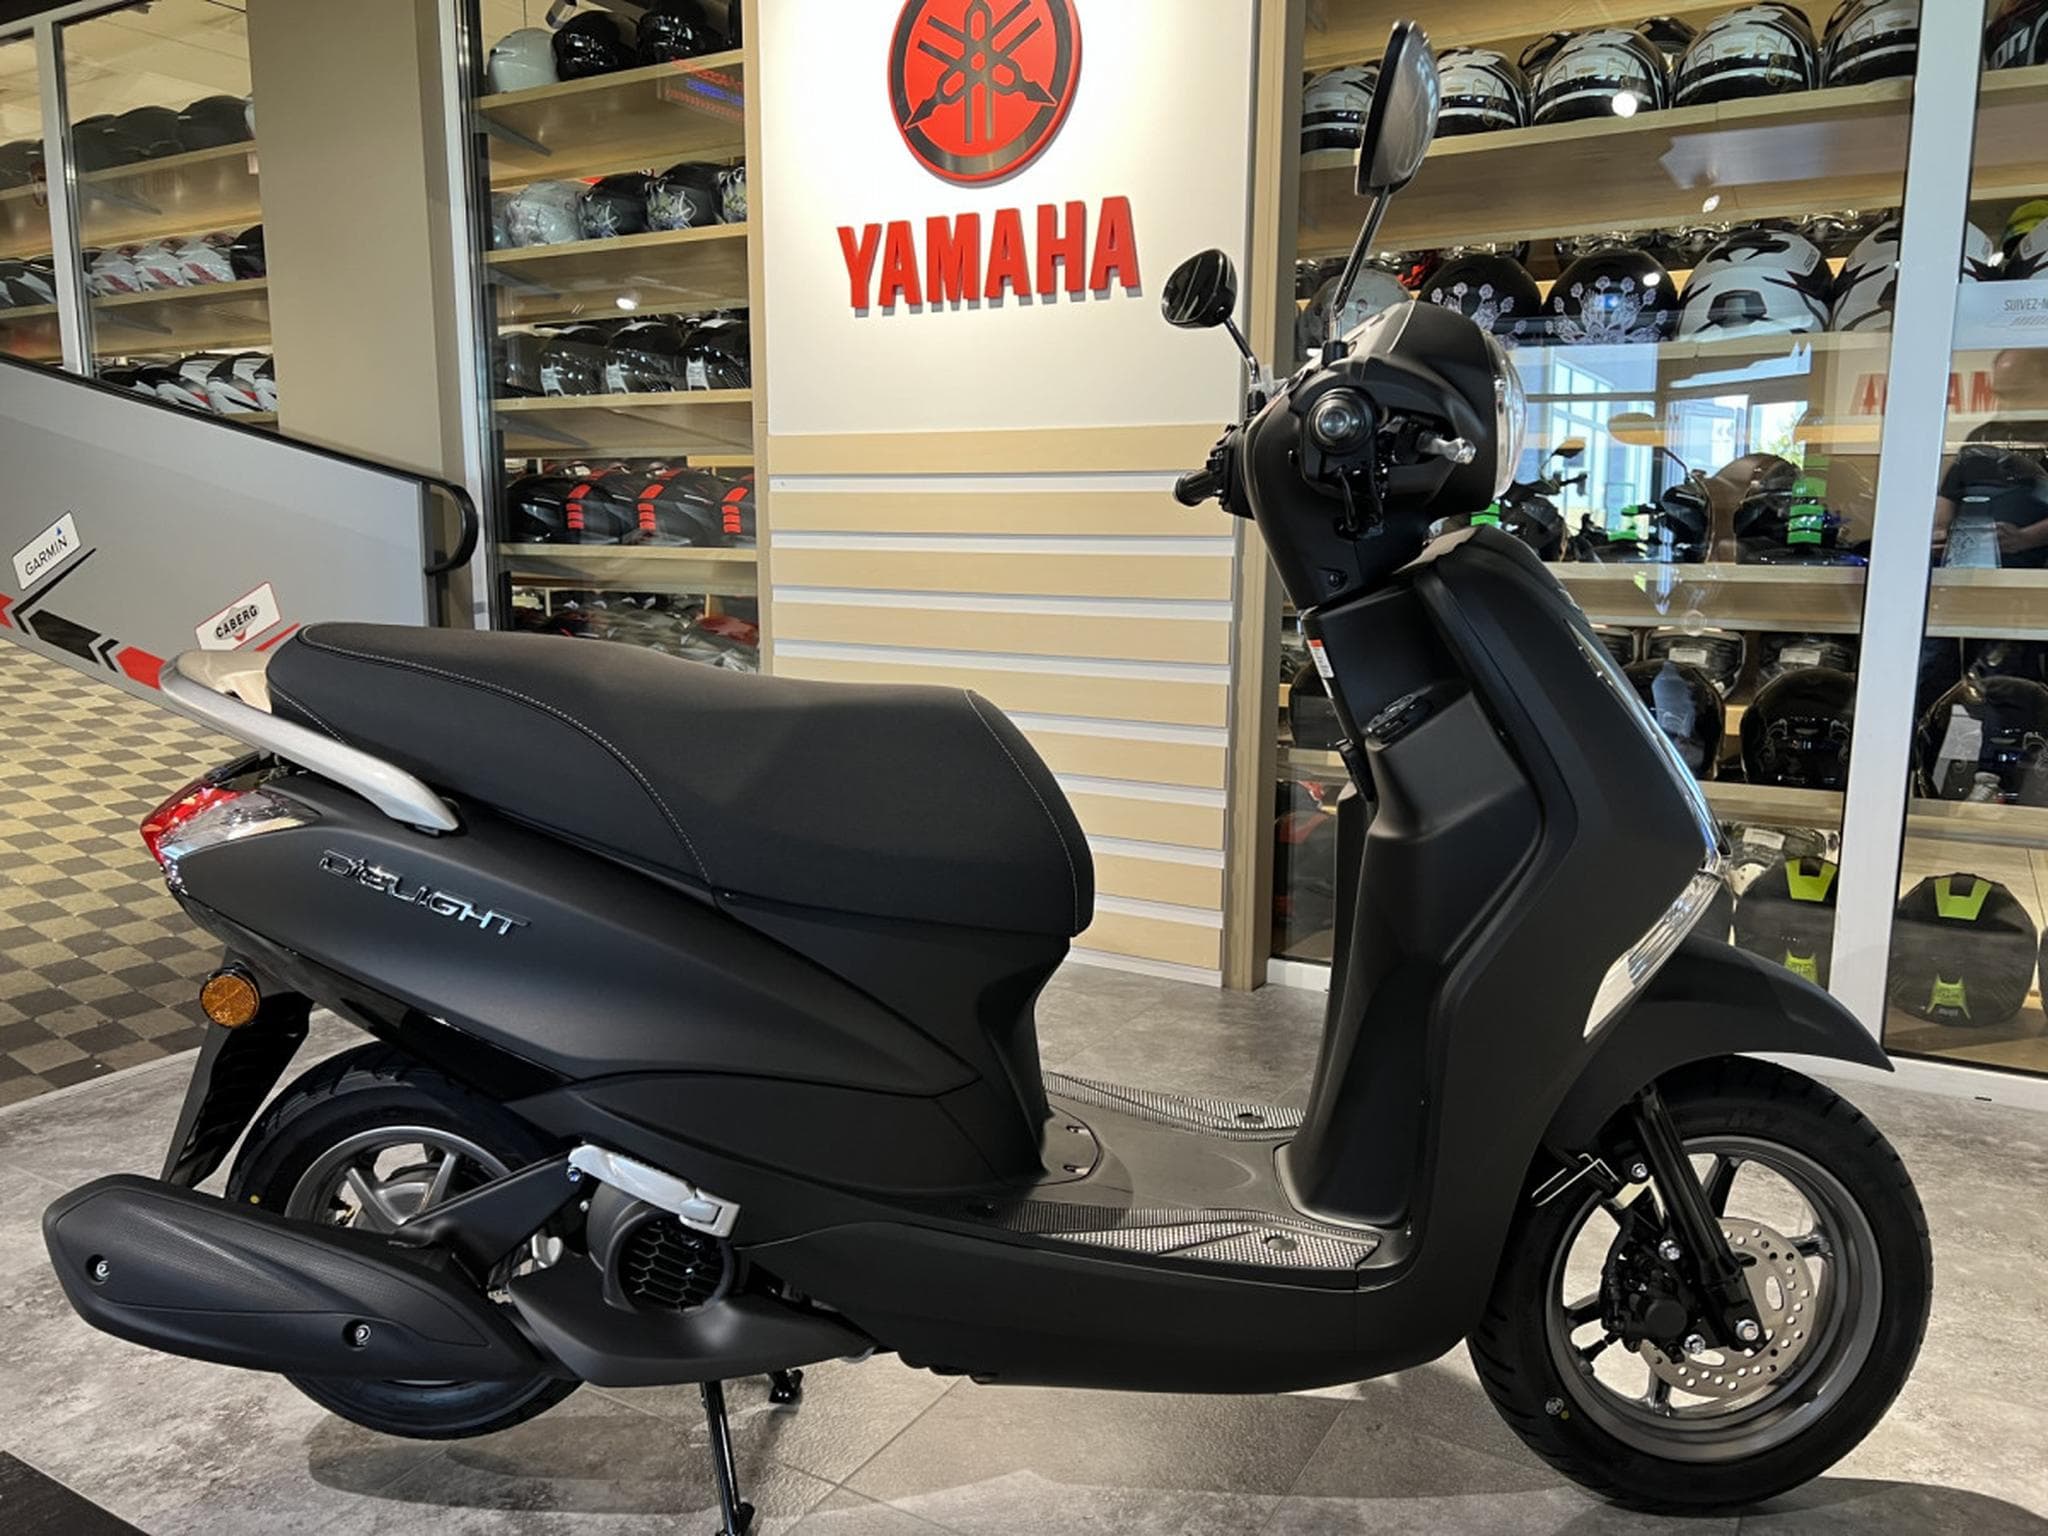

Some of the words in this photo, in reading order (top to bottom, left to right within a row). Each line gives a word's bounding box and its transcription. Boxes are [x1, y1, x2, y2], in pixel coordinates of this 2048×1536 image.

[837, 195, 1142, 309] YAMAHA
[25, 536, 68, 576] GARMIN
[215, 604, 258, 638] CABERG
